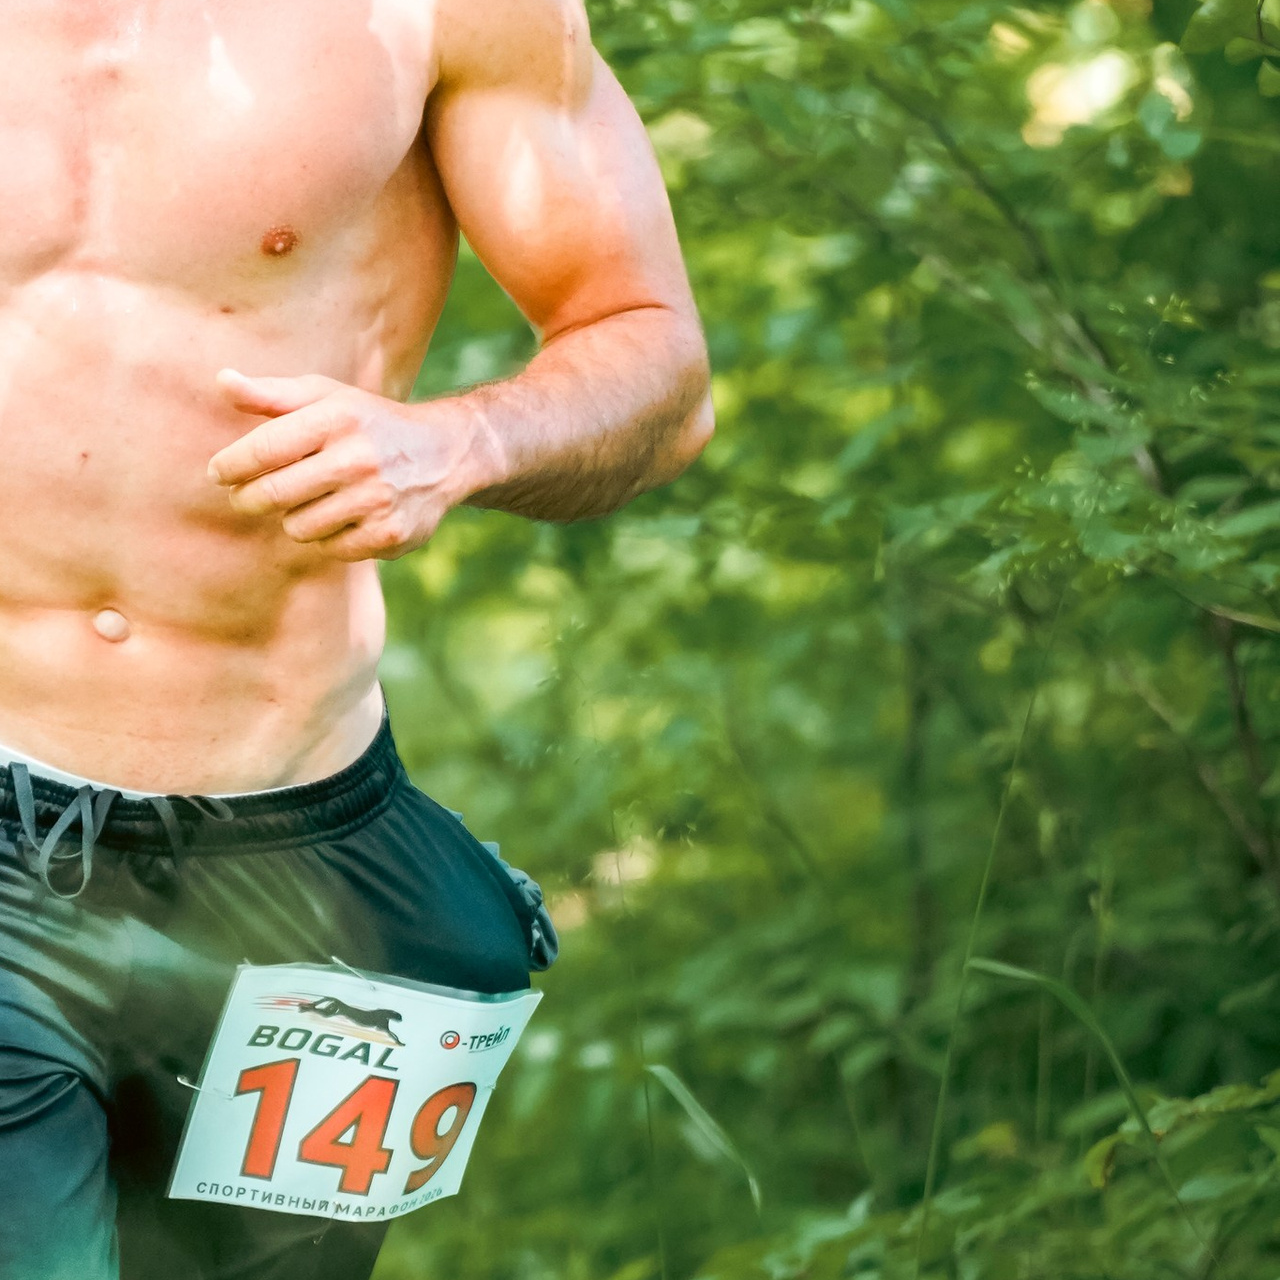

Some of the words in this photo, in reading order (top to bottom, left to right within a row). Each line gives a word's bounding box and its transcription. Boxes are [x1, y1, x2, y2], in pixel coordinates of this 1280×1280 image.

[247, 1025, 402, 1071] BOGAL
[233, 1057, 478, 1196] 149
[196, 1181, 330, 1212] СПОРТИВНЫЙ
[335, 1195, 418, 1218] МАРАФОН
